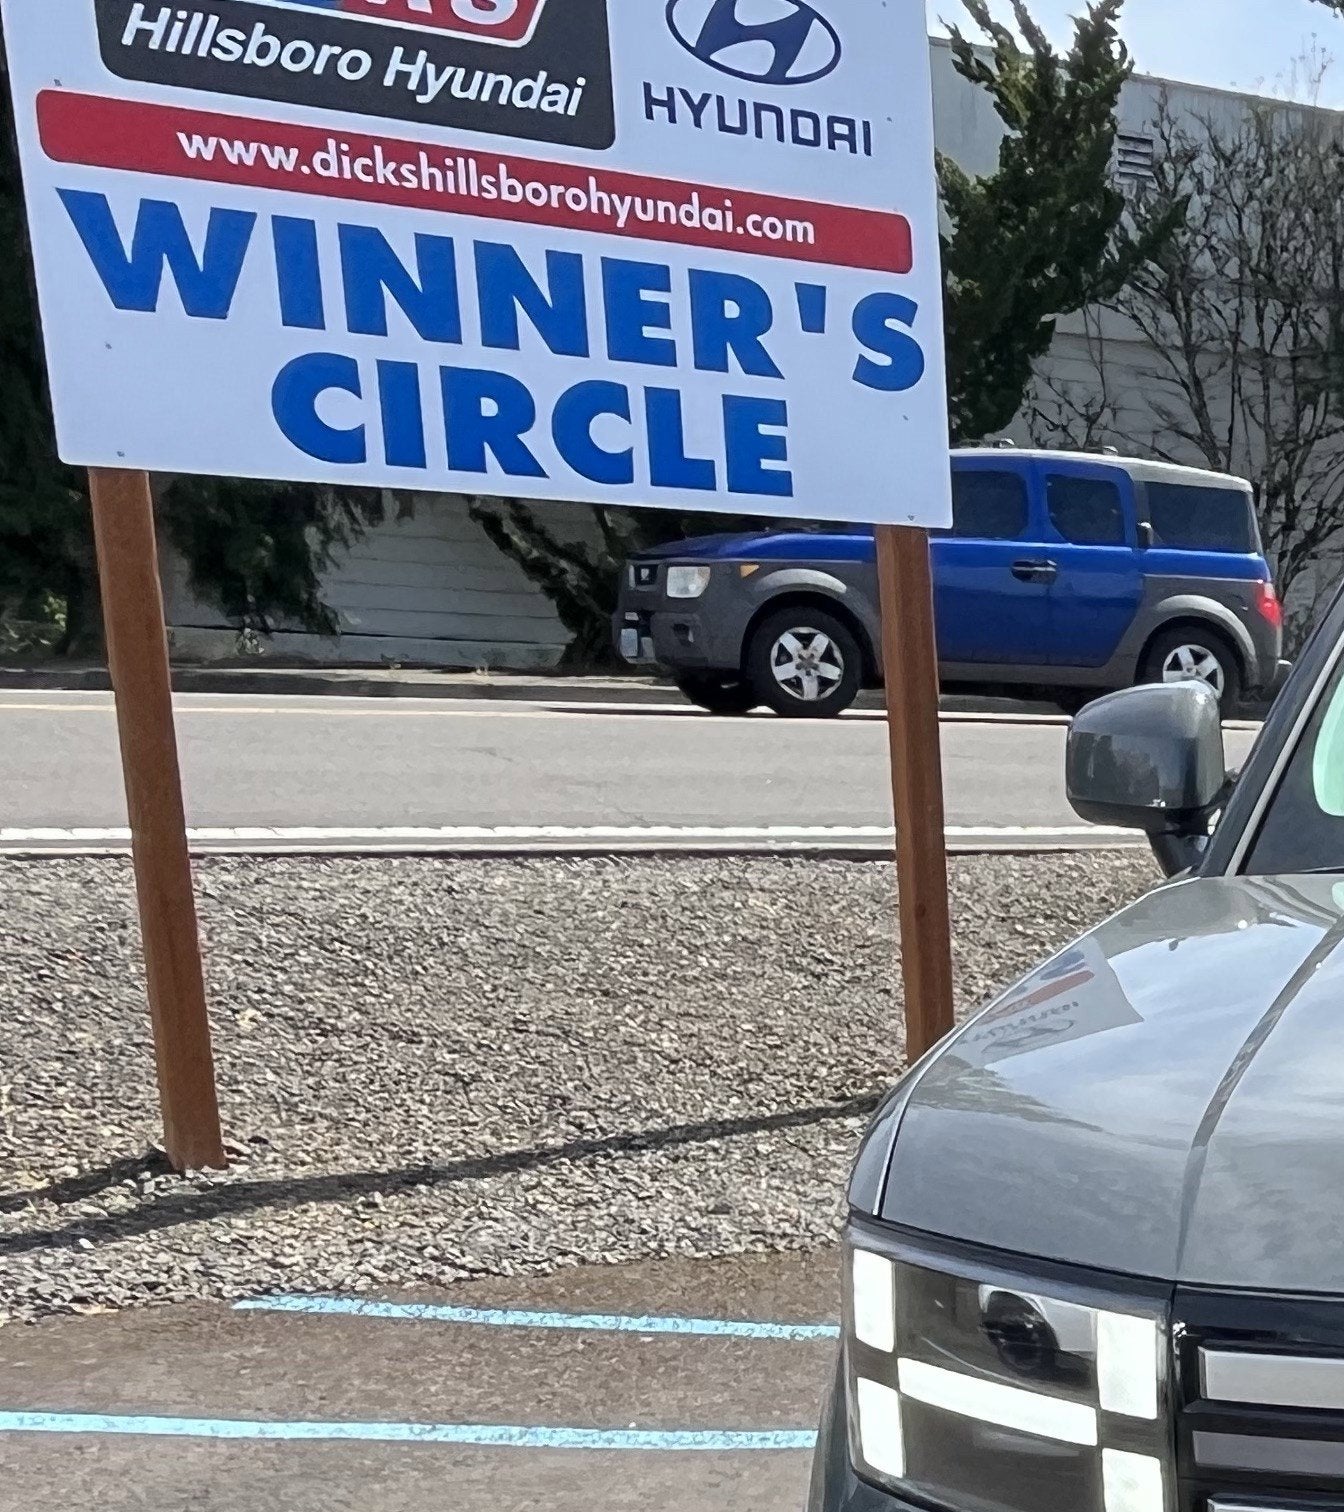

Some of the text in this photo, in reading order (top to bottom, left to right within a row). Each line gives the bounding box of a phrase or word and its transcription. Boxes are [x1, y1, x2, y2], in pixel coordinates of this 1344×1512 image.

[121, 2, 586, 117] Hillsboro Hyundai
[642, 81, 873, 157] HYUNDAI
[175, 126, 816, 246] www.dickshillsborohyundai.com
[55, 186, 926, 393] WINNER'S
[270, 351, 795, 499] CIRCLE
